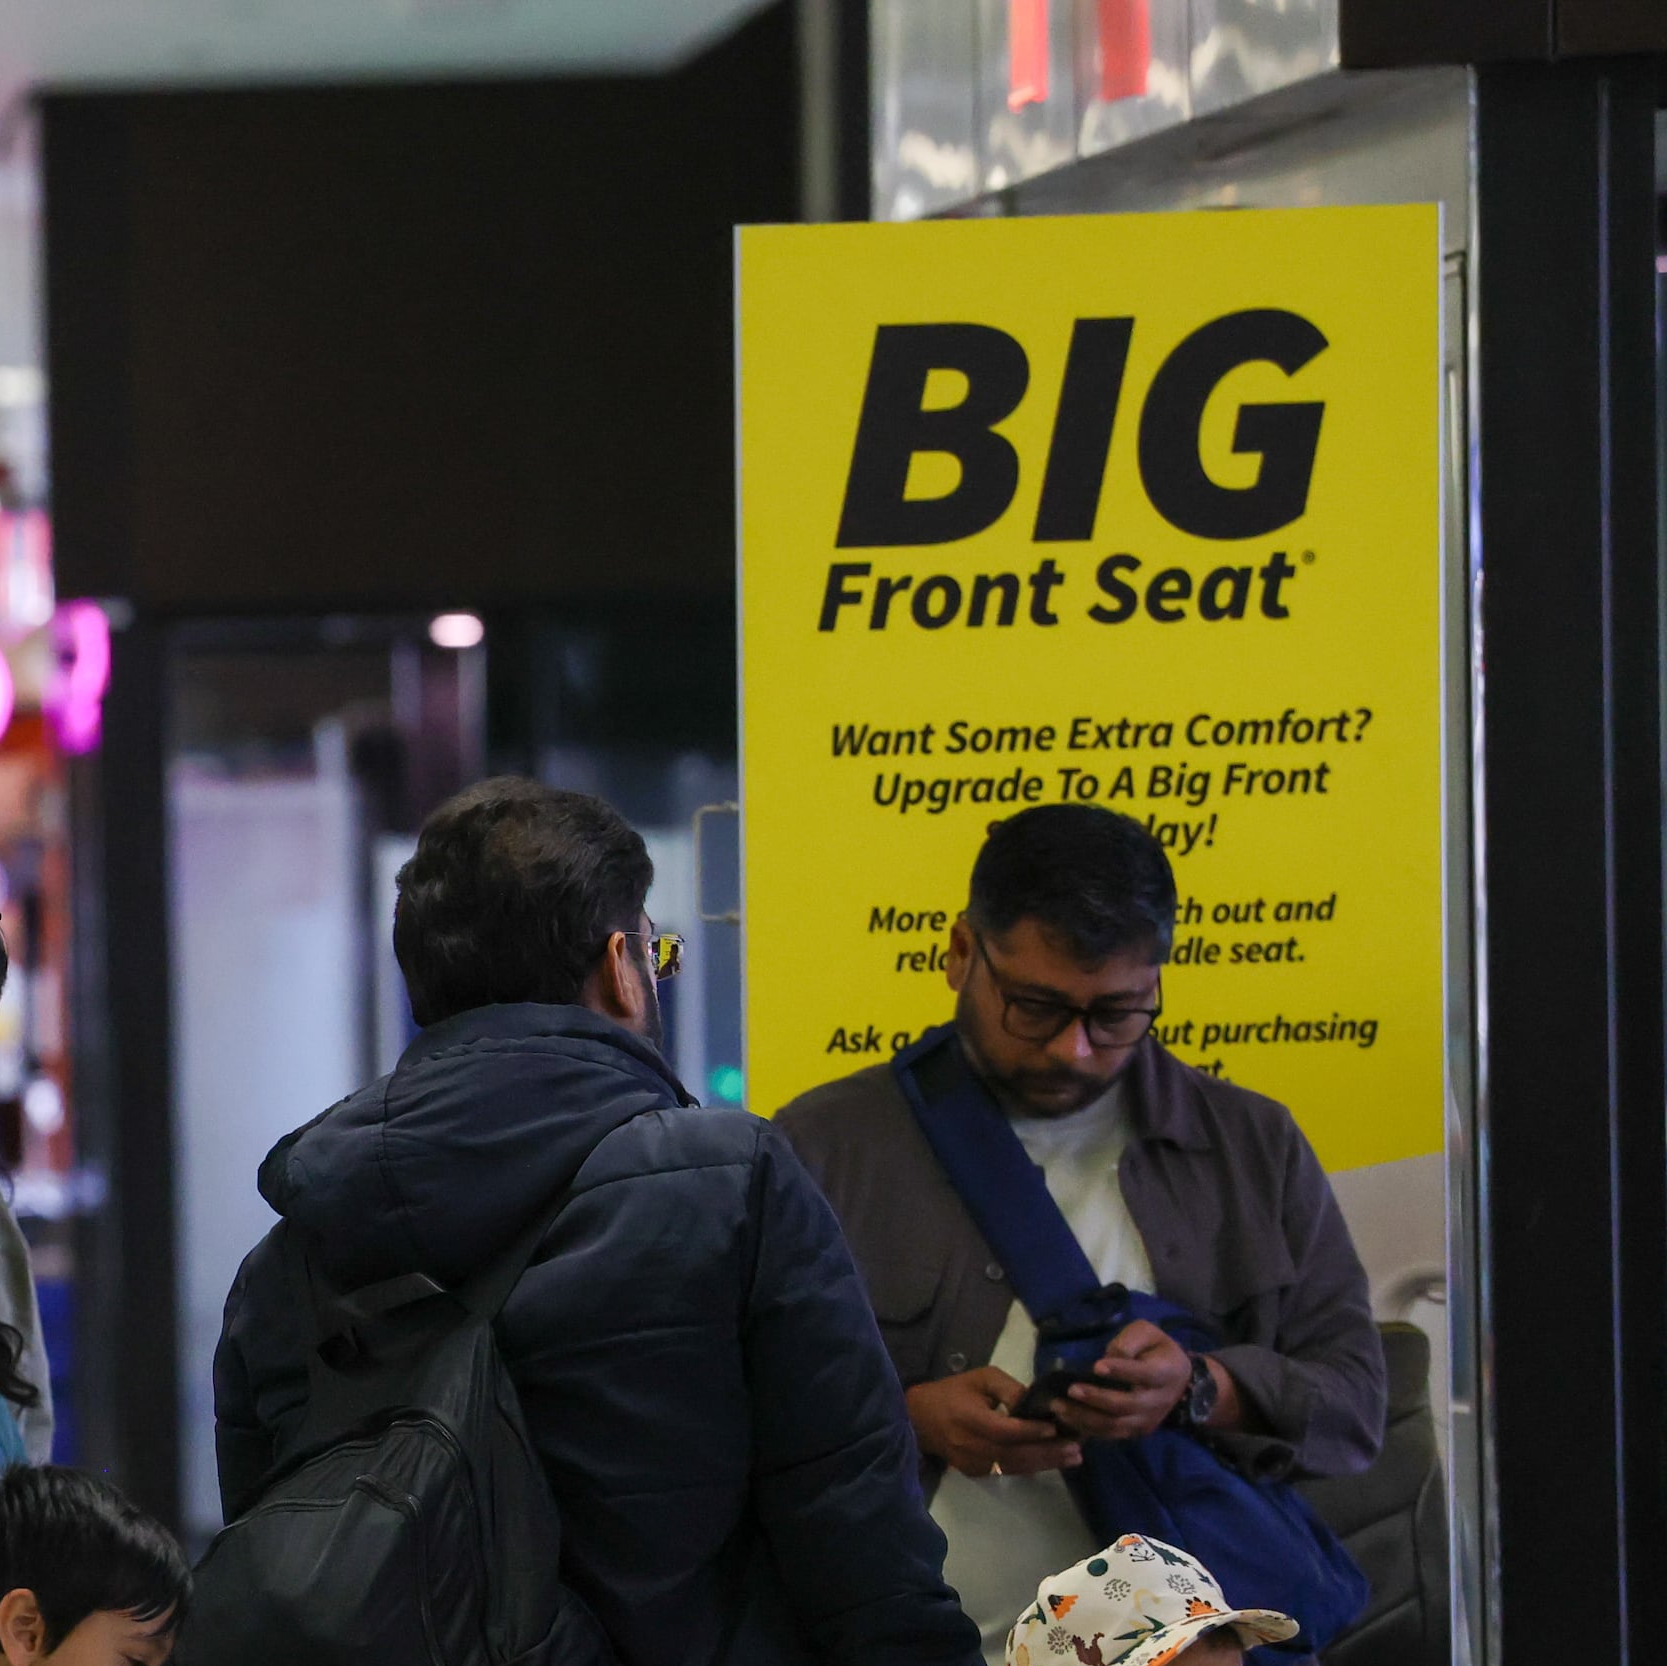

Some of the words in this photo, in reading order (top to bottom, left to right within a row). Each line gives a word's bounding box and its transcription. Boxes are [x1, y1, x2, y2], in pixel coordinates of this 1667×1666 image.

[835, 308, 1329, 548] BIG
[818, 559, 1065, 632] Front
[832, 723, 936, 757] Want
[945, 721, 1056, 754] Some
[1068, 717, 1174, 750] Extra
[1185, 707, 1373, 747] Comfort?
[873, 766, 1044, 815] Upgrade
[1058, 768, 1100, 801] To
[1108, 766, 1135, 799] A
[1147, 762, 1212, 807] Big
[1223, 761, 1331, 797] Front
[868, 906, 948, 933] More
[1211, 897, 1267, 924] out
[1273, 891, 1338, 922] and
[1228, 936, 1306, 965] seat.
[825, 1025, 883, 1054] Ask
[1199, 1012, 1379, 1052] purchasing
